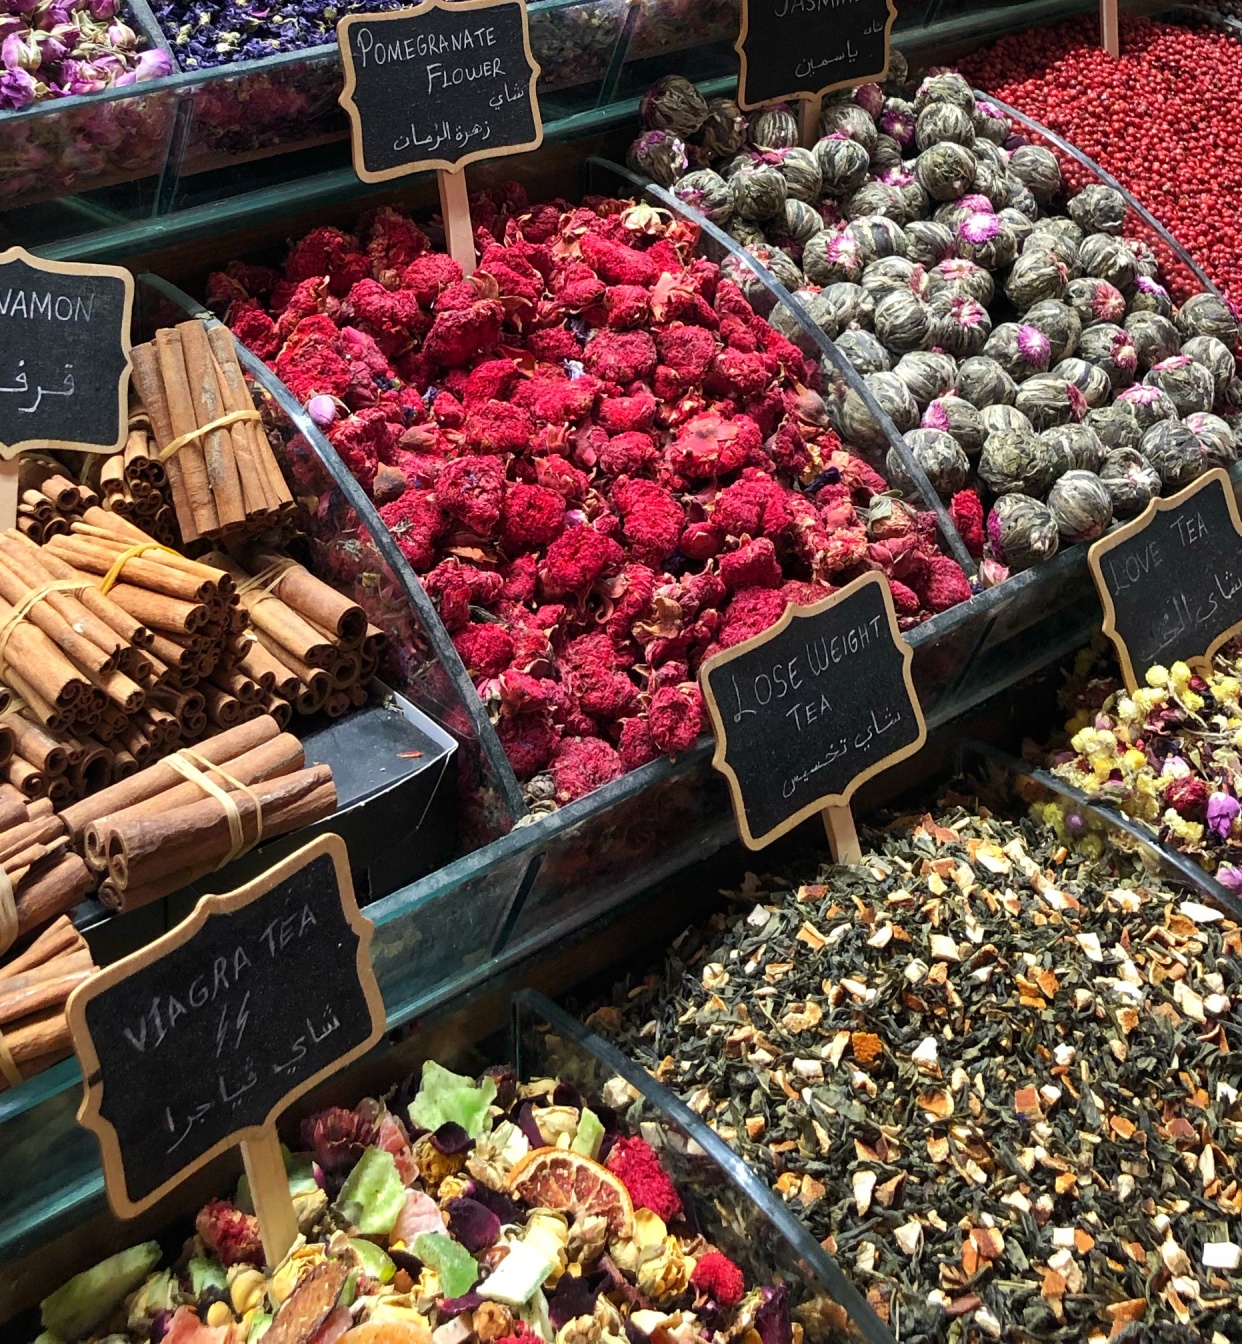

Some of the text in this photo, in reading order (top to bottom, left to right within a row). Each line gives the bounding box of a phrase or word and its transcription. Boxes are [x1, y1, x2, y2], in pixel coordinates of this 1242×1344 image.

[356, 27, 497, 68] POMEGRANATE
[794, 40, 859, 78] ياسمين
[426, 57, 506, 95] FLOWER
[455, 120, 491, 149] زهرة
[1109, 511, 1209, 596] LOVE TEA
[732, 614, 881, 723] LOSE WEIGHT
[786, 694, 833, 731] TEA
[124, 902, 318, 1052] VIAGRA TEA
